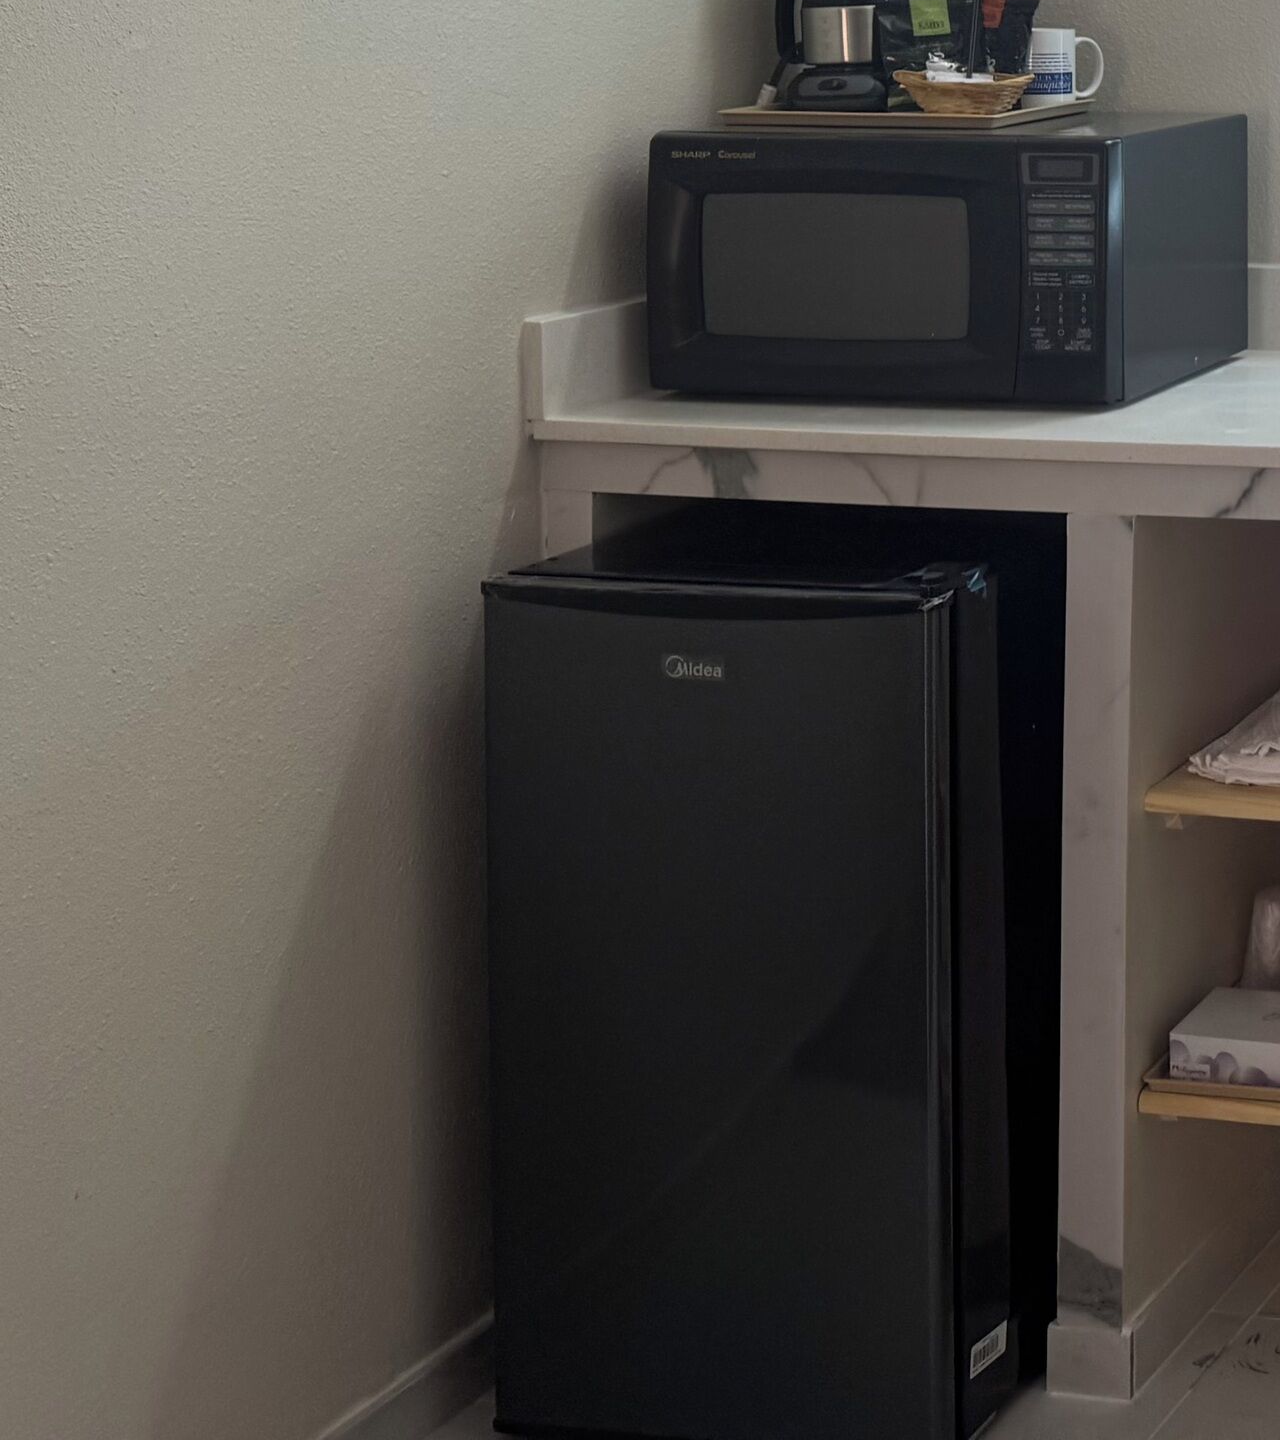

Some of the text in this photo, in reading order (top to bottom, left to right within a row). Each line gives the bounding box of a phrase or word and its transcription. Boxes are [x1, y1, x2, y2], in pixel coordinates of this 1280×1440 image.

[671, 150, 756, 159] SHARP Carousel
[665, 654, 722, 678] Midea
